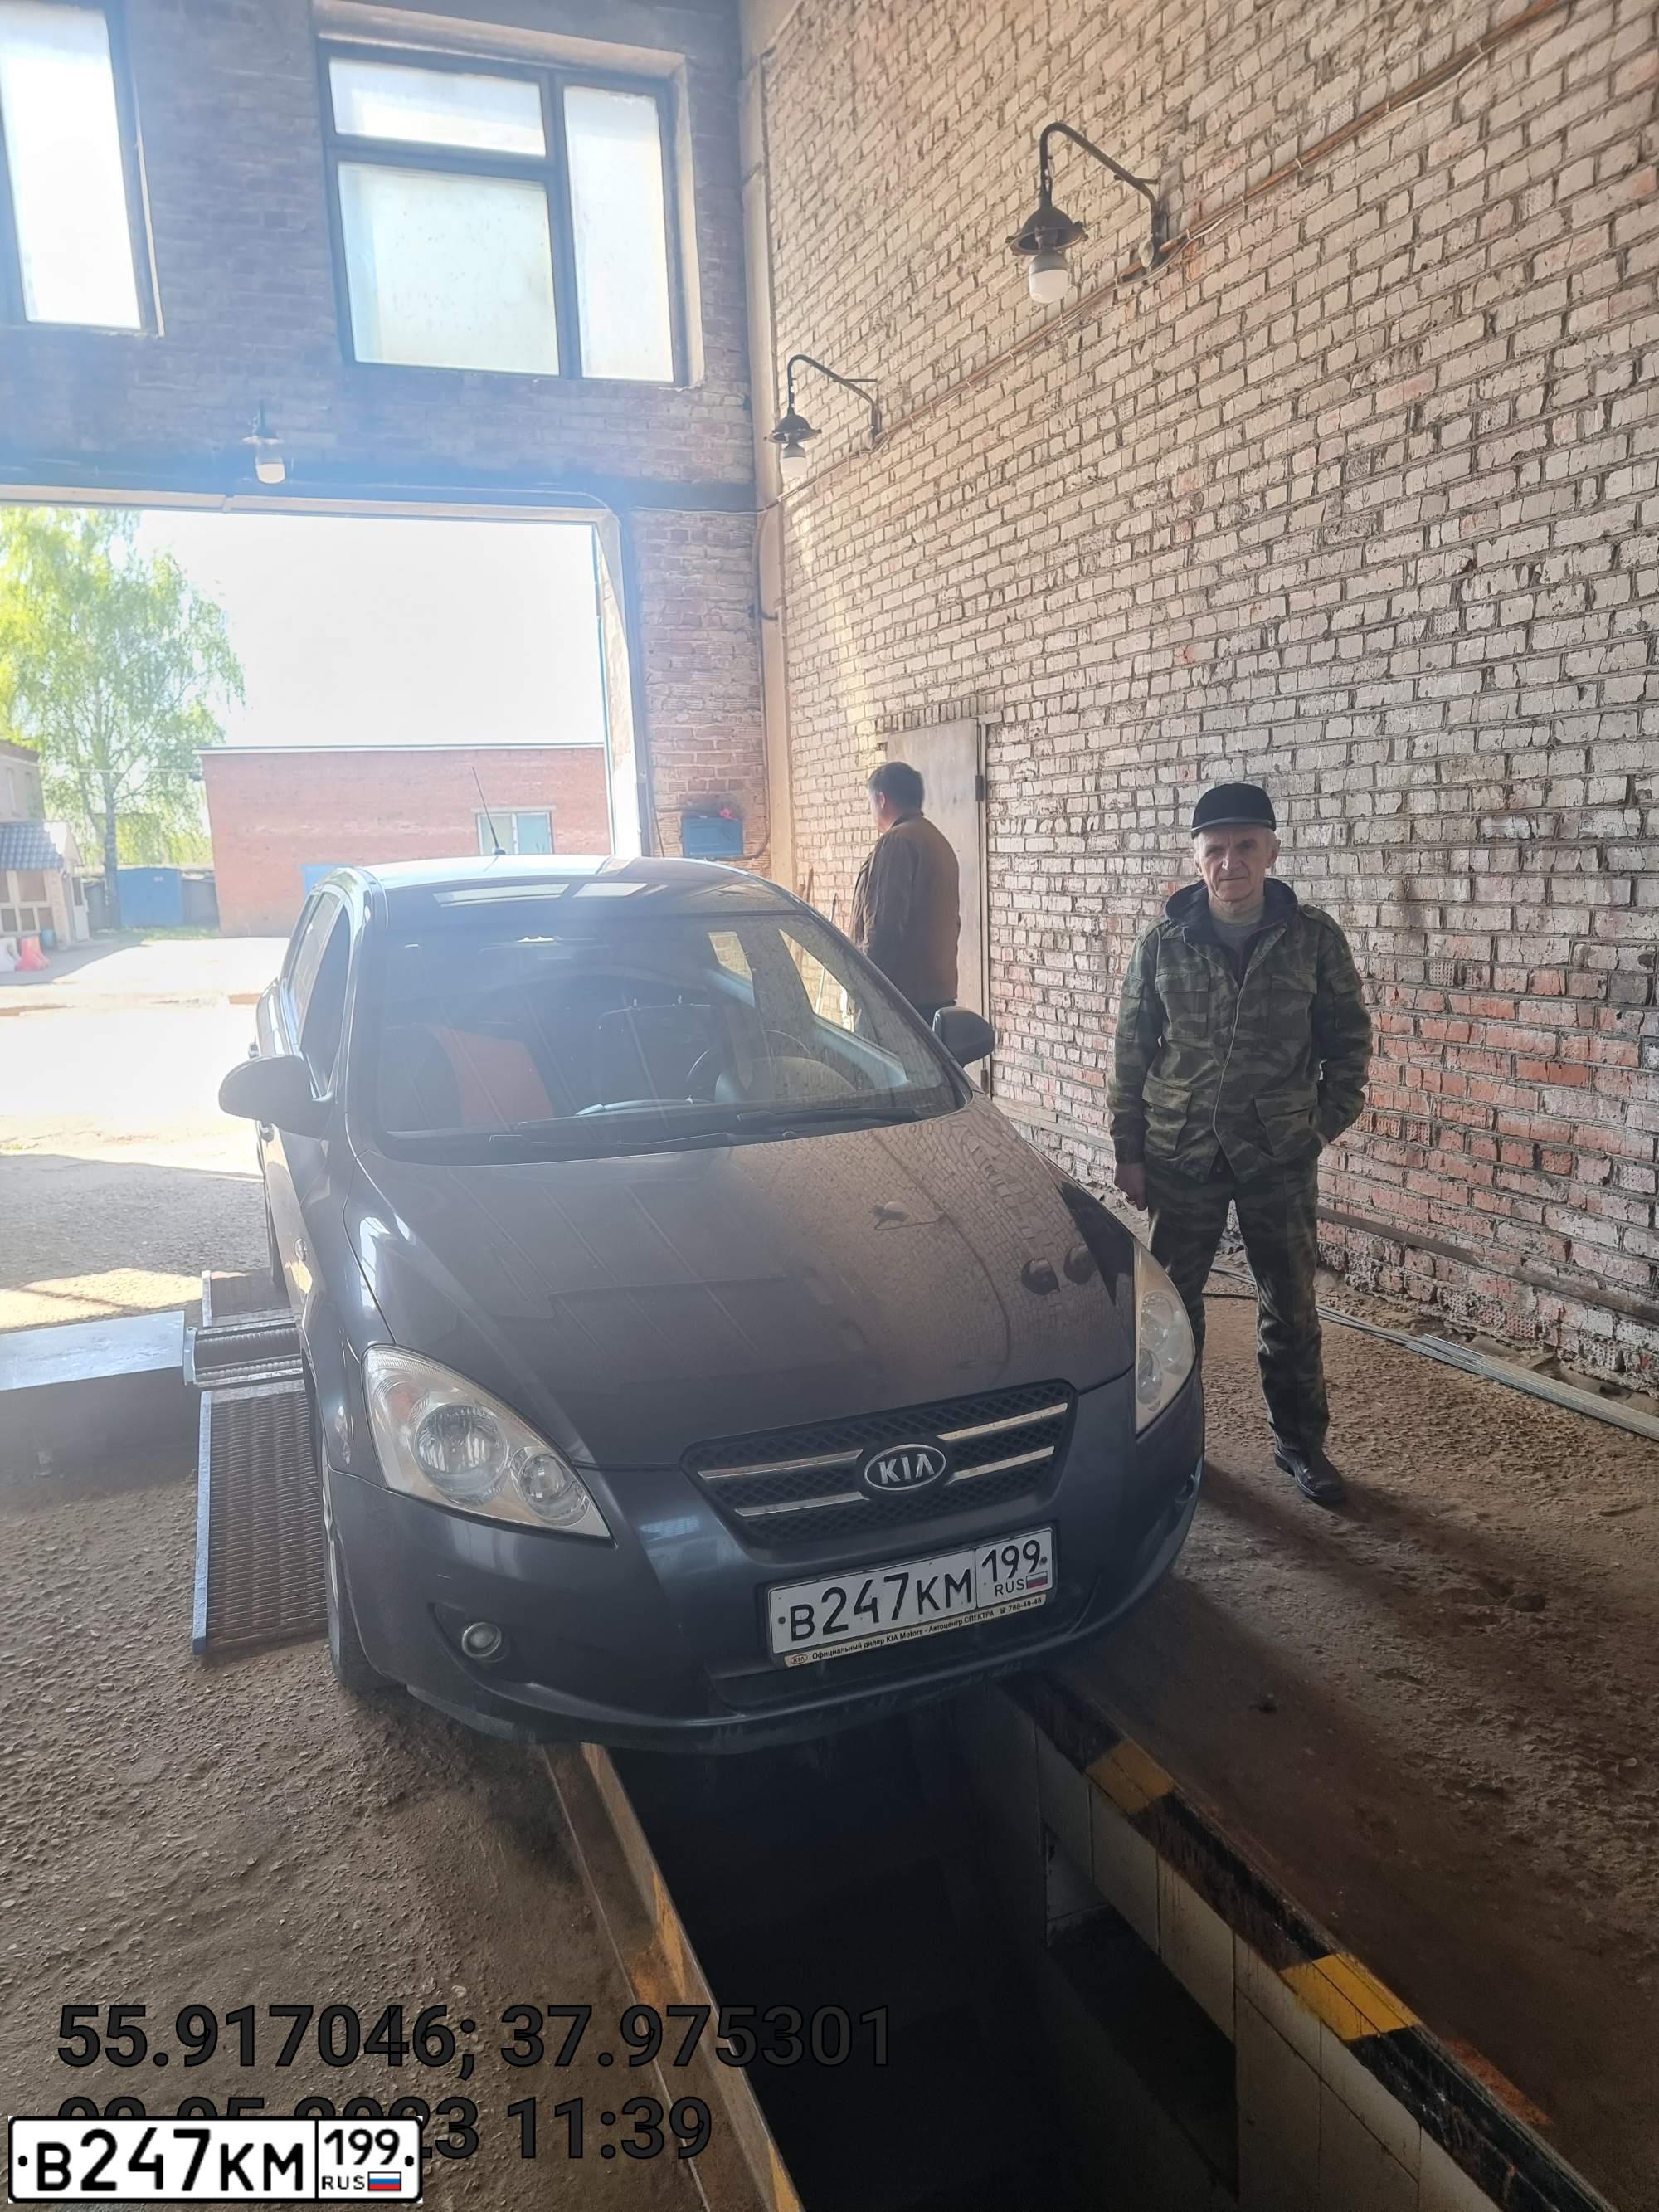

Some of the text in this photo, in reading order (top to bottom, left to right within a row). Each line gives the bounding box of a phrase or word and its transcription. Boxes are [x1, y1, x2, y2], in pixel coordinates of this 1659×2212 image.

[878, 1453, 935, 1484] KIA
[790, 1539, 1041, 1642] В247КМ 199
[995, 1578, 1025, 1597] RUS
[812, 1643, 862, 1659] Официальный
[864, 1638, 885, 1649] дилер
[886, 1632, 898, 1643] KIA
[900, 1628, 923, 1640] Motors
[928, 1620, 963, 1633] Автоцентр
[964, 1610, 995, 1624] СПЕКТРА
